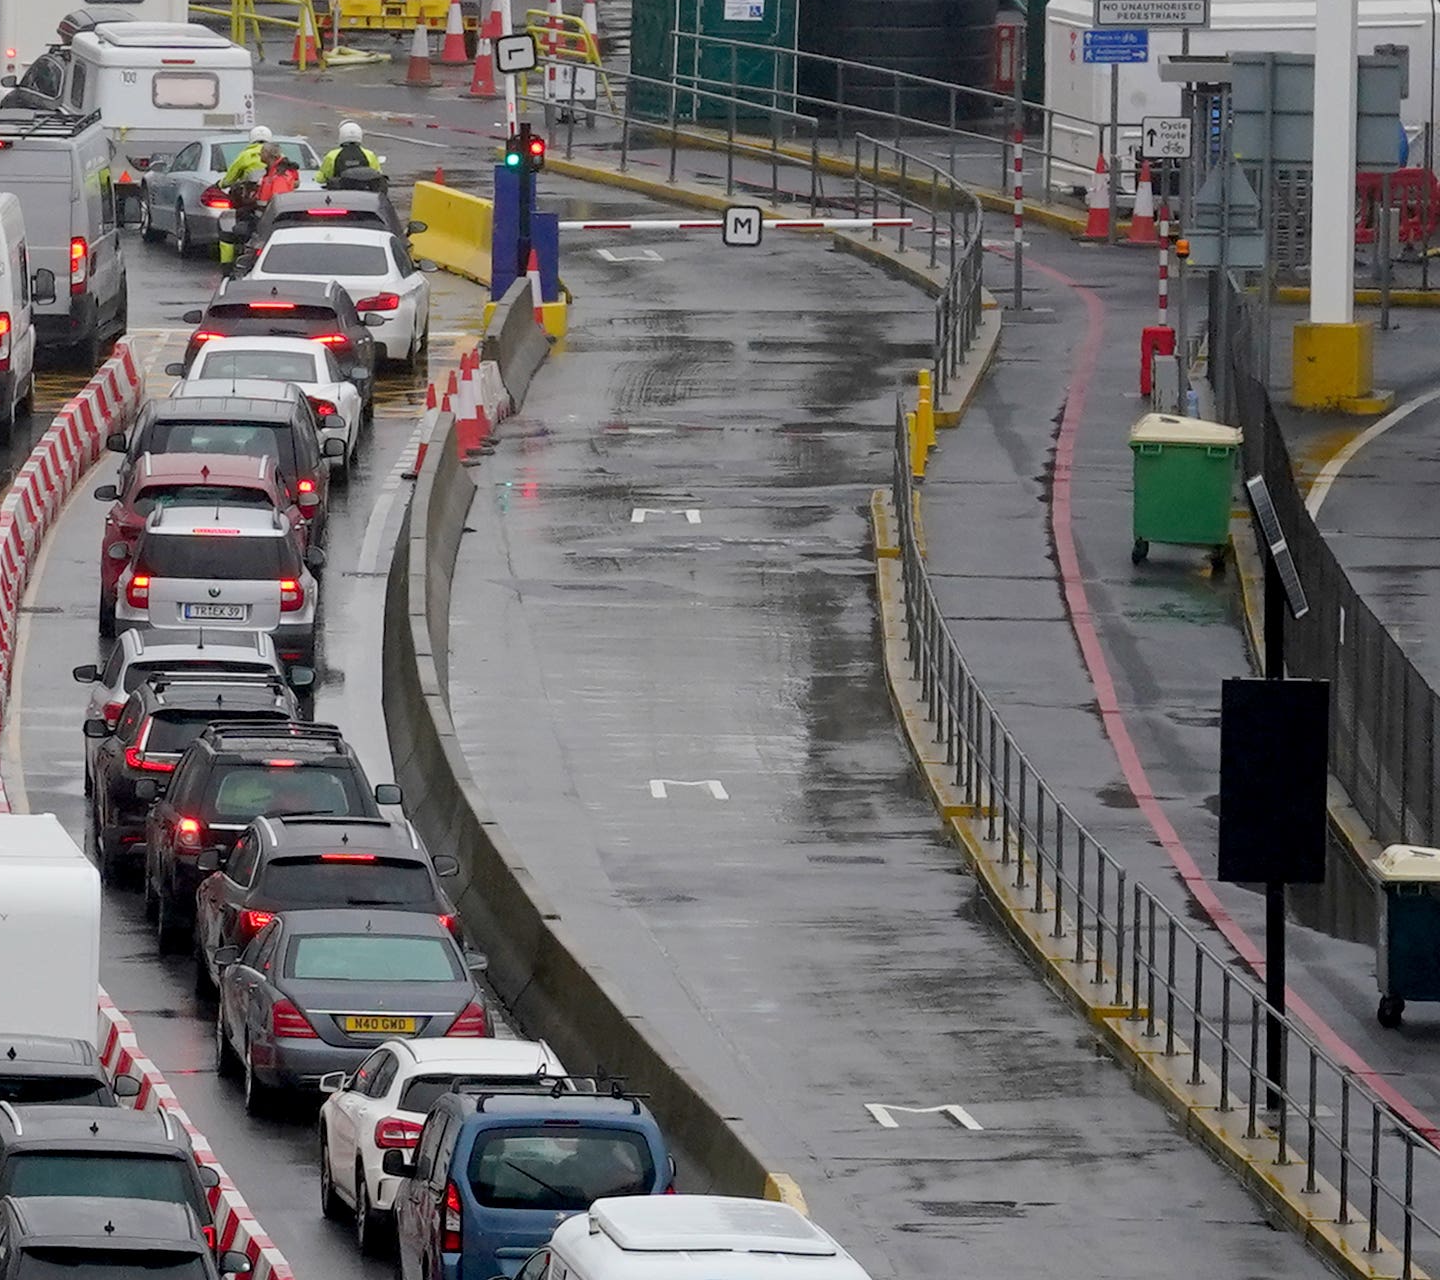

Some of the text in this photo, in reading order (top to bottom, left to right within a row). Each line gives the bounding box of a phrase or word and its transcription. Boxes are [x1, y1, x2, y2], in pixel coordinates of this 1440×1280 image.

[1102, 1, 1201, 12] NO UNAUTHORISED
[1117, 11, 1186, 21] PEDESTRIANS
[1160, 121, 1187, 131] Cycle
[734, 218, 752, 235] M
